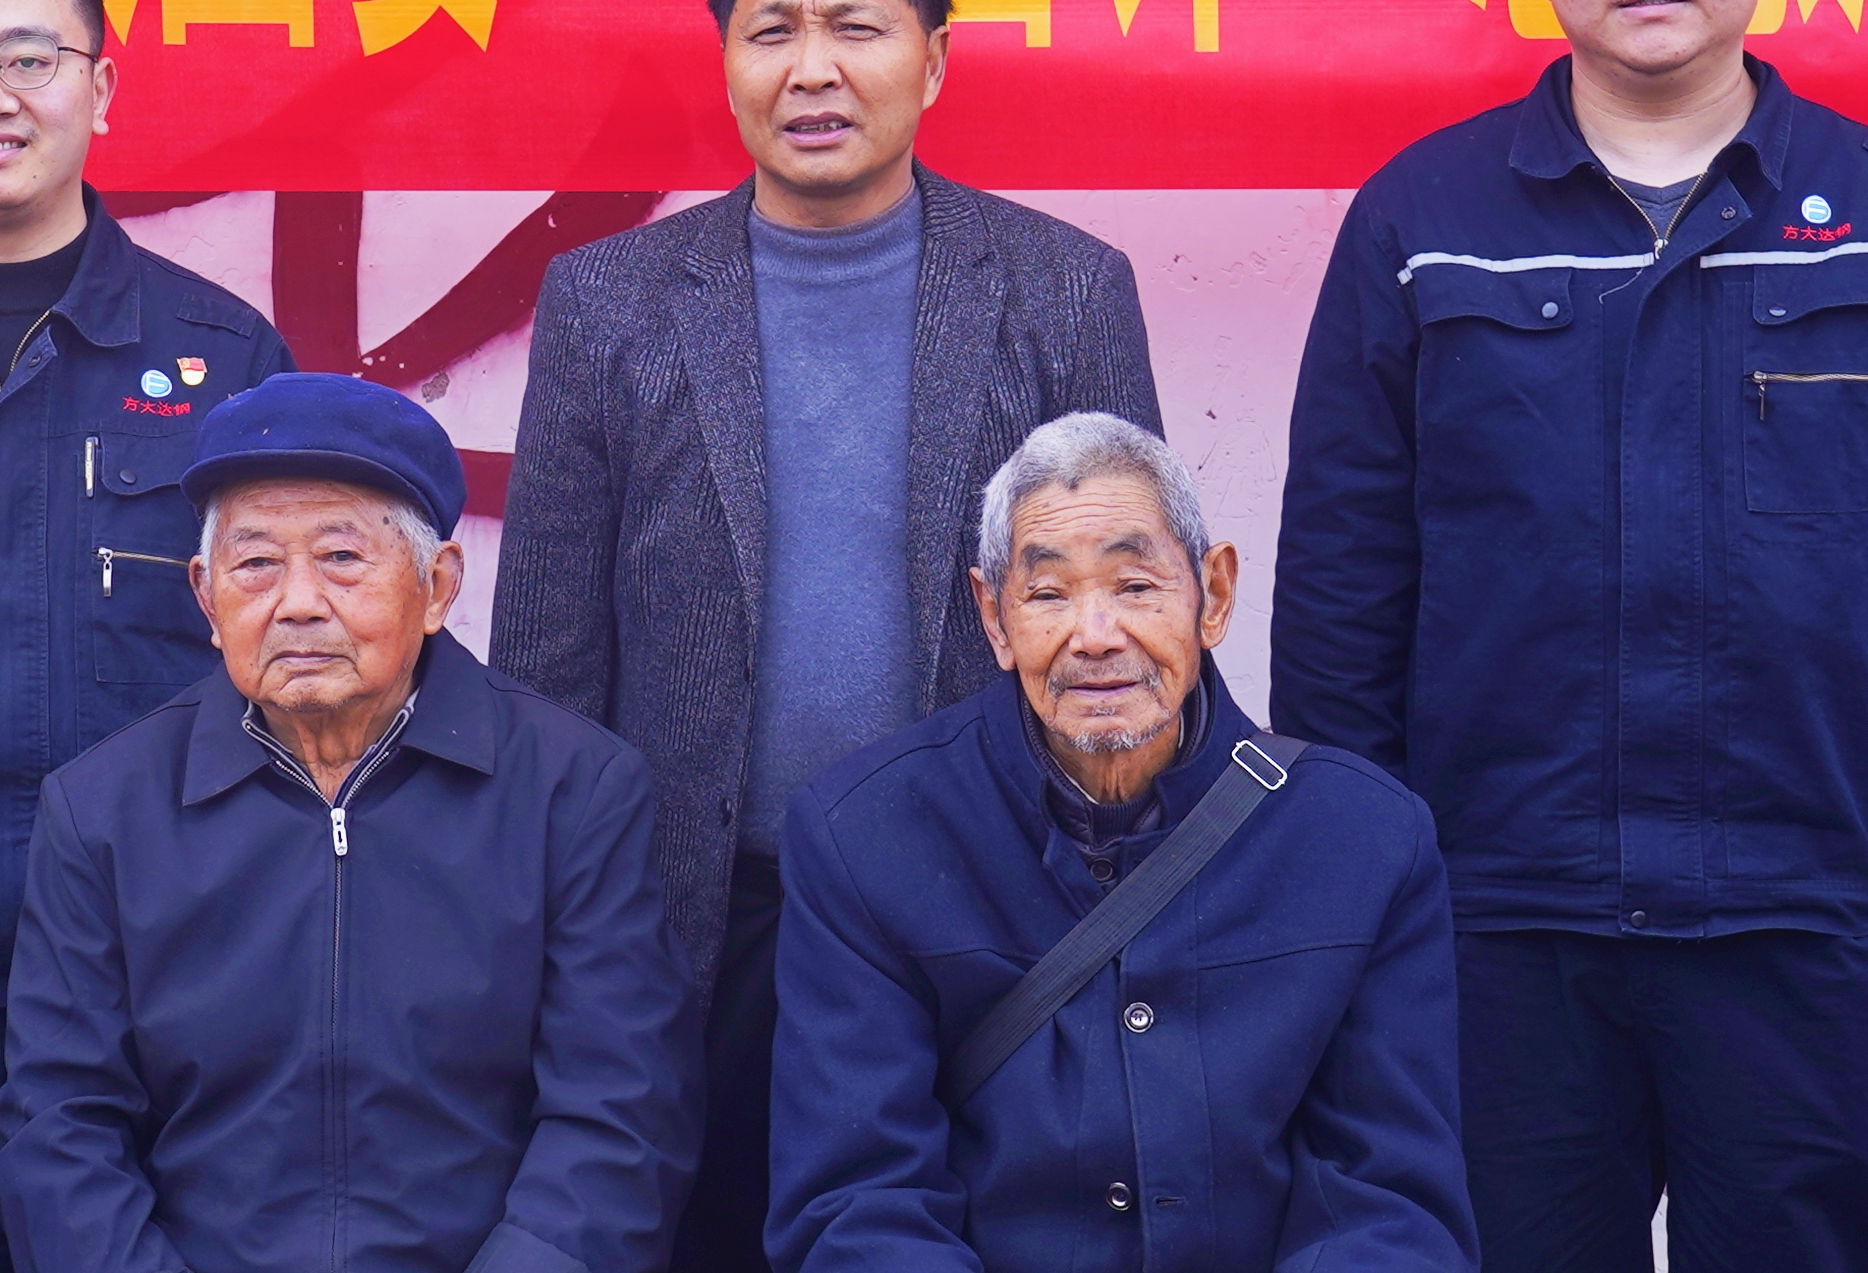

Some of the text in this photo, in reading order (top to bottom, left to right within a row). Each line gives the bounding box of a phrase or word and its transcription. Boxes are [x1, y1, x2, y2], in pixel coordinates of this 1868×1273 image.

[1782, 223, 1852, 242] 方大达钢
[122, 396, 192, 417] 方大达钢
